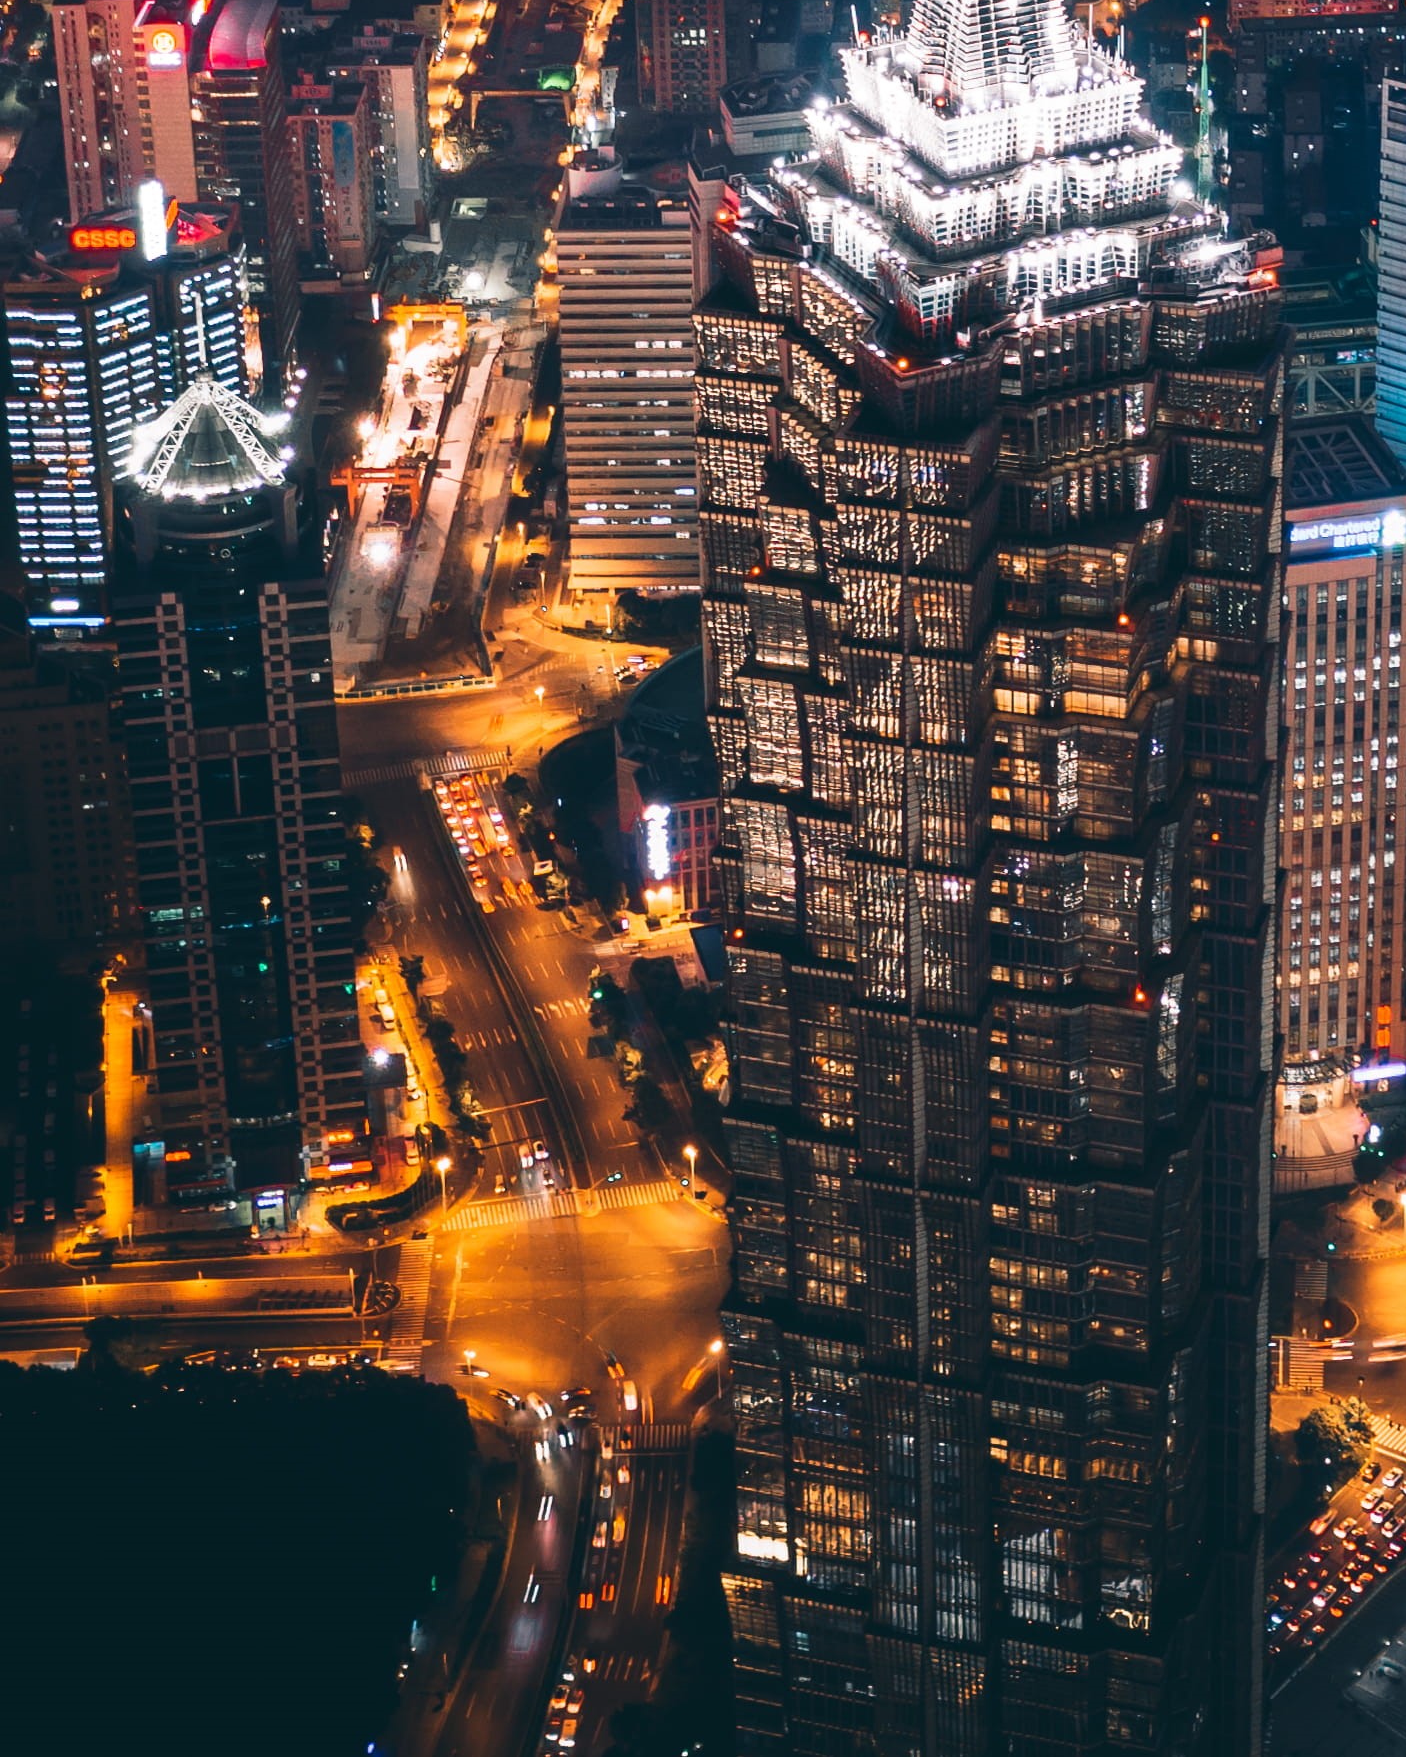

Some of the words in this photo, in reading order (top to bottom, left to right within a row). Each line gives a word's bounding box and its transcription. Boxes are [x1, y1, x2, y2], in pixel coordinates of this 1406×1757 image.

[73, 229, 136, 248] CSSC
[1291, 525, 1318, 542] dard
[1320, 517, 1380, 537] Chartered
